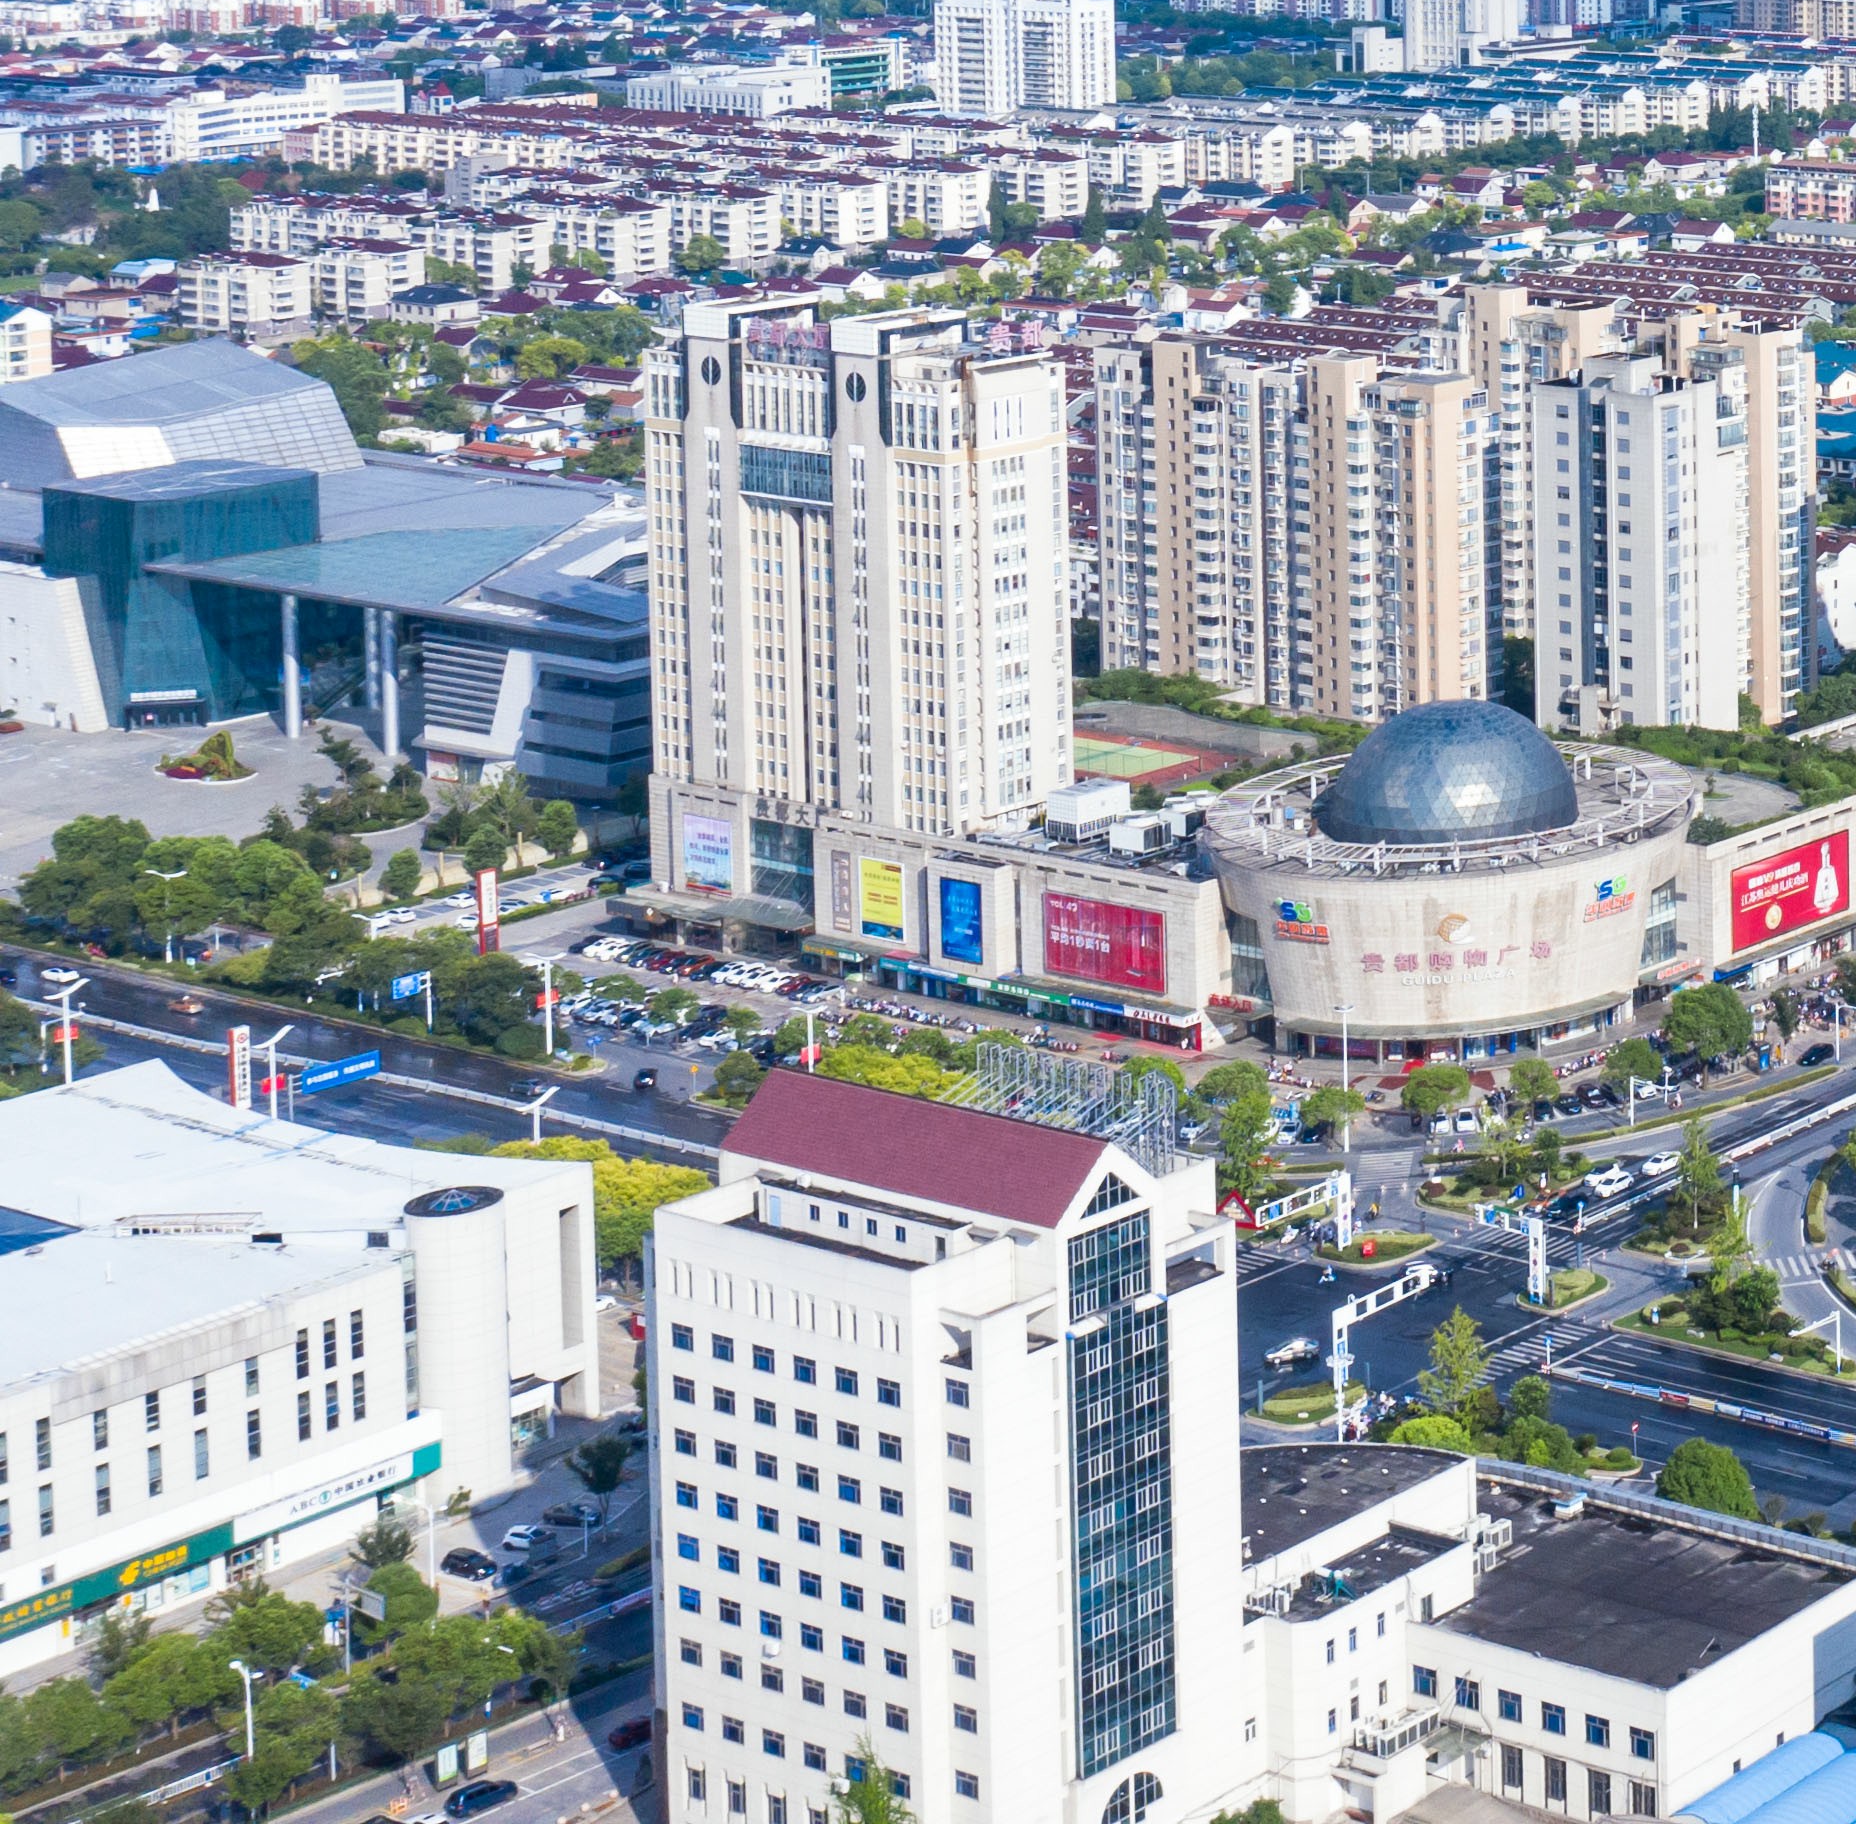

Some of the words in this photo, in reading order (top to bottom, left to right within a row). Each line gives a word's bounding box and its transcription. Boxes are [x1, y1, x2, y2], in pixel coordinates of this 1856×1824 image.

[1361, 941, 1552, 973] 贵都购物广场
[1402, 975, 1455, 986] GUIDU
[1462, 968, 1515, 984] PLAZA
[334, 1465, 397, 1495] 中国农业银行
[290, 1496, 317, 1514] ABC
